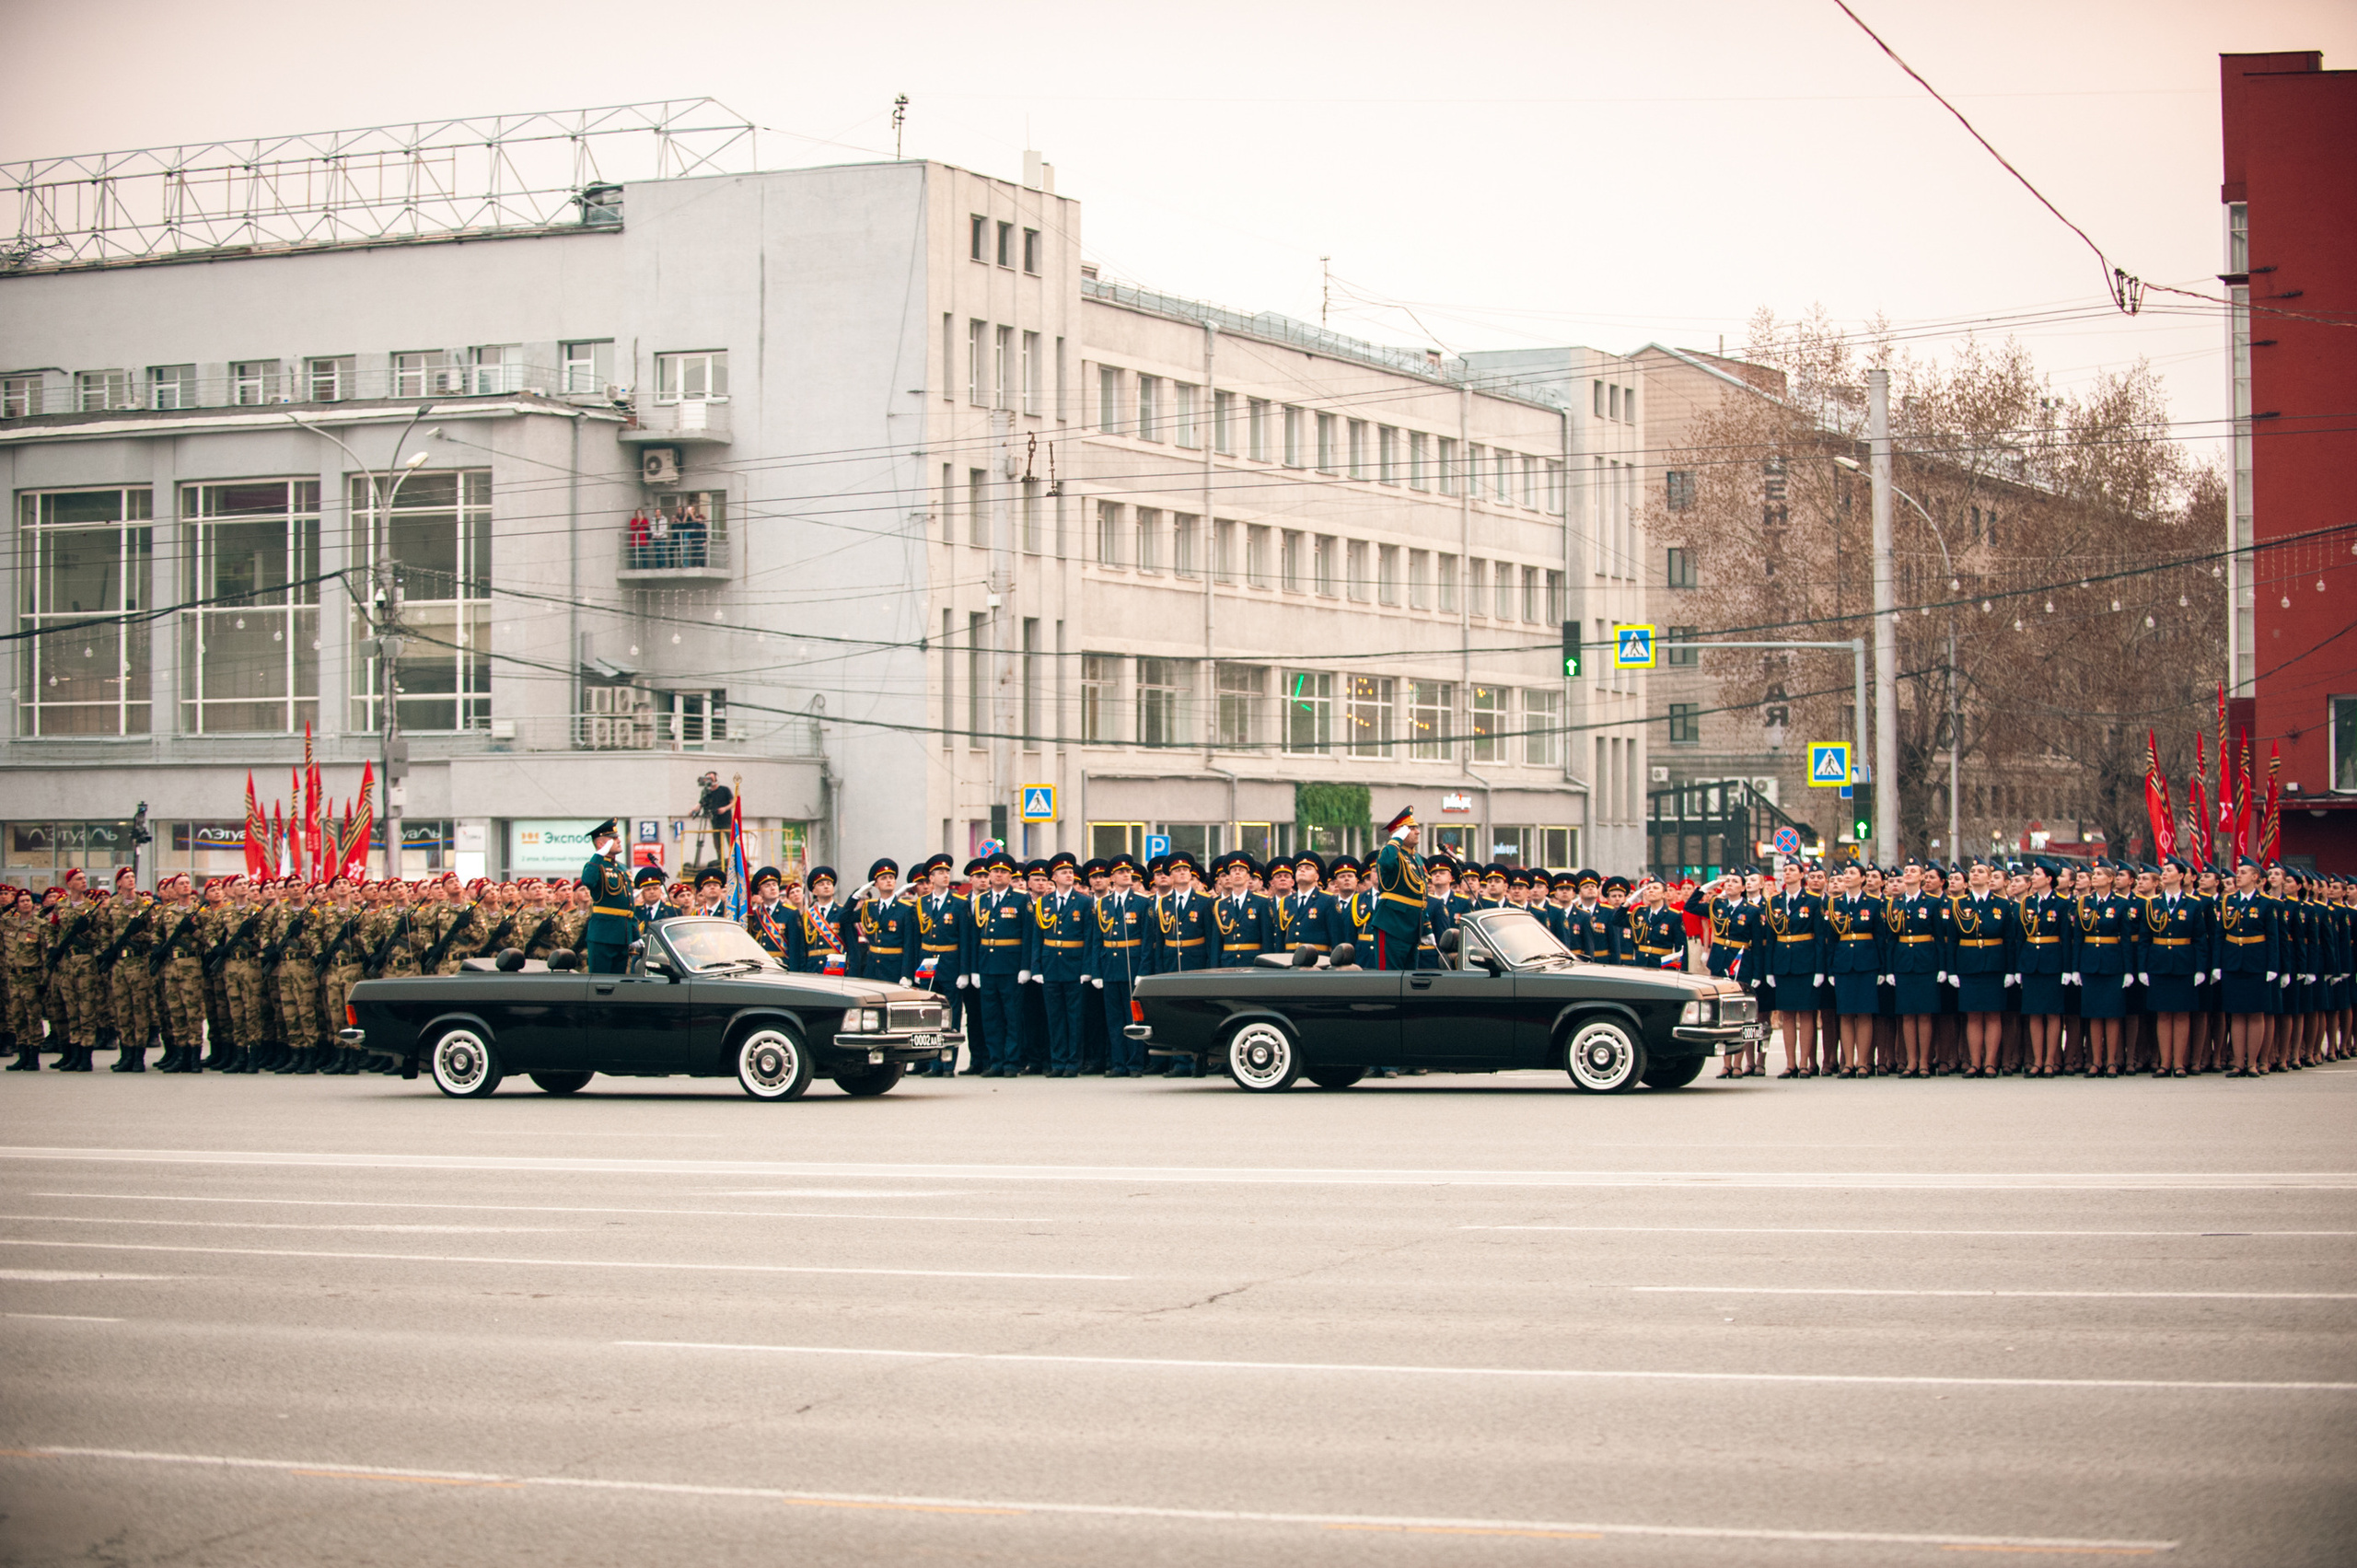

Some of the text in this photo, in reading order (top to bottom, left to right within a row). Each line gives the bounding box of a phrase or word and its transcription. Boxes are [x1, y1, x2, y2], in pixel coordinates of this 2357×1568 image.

[642, 822, 656, 836] 25
[544, 831, 592, 844] Экспоб
[913, 1034, 931, 1047] 0002
